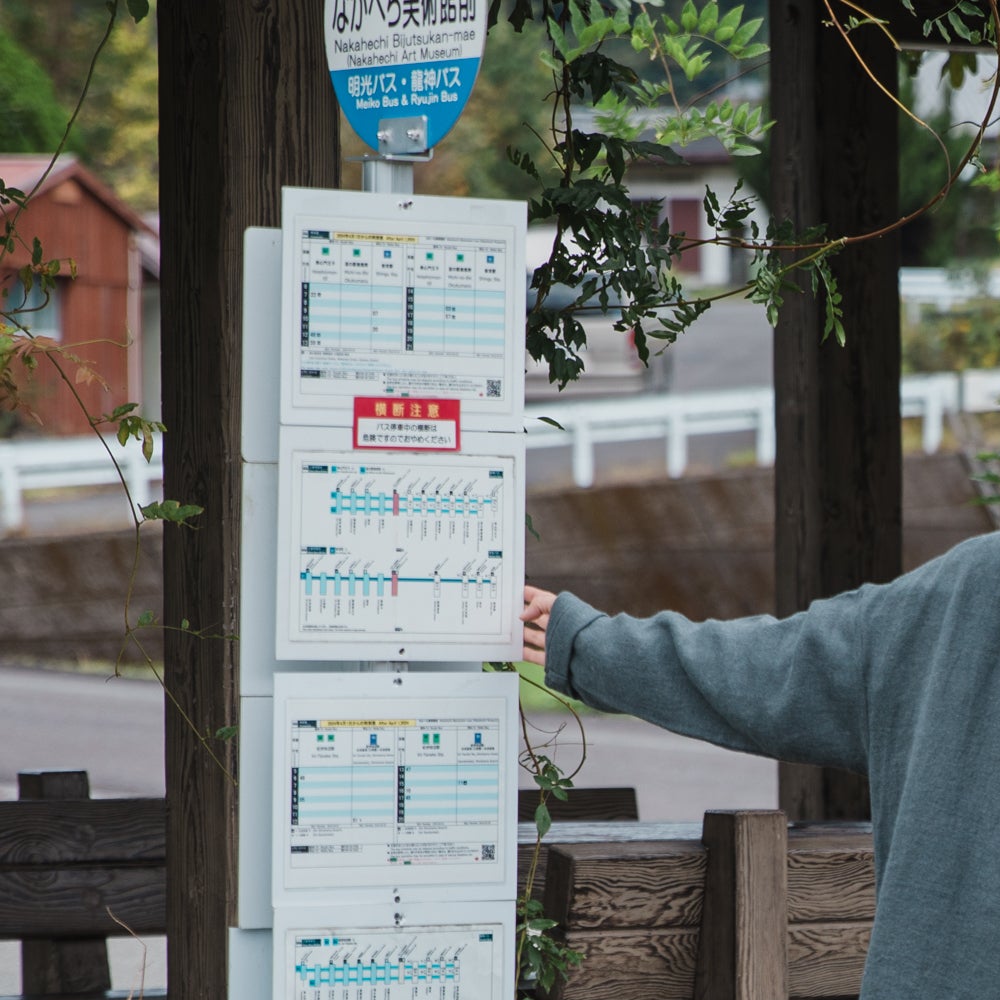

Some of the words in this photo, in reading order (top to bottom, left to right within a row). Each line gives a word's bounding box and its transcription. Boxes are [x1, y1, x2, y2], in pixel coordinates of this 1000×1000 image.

[334, 35, 389, 53] Nakahechi
[392, 30, 476, 49] Bijutsukan-mae
[346, 51, 398, 67] (Nakahechi
[402, 49, 417, 61] Art
[420, 44, 463, 60] Museum)
[356, 98, 380, 110] Meiko
[382, 95, 399, 108] Bus
[401, 94, 408, 106] &
[410, 92, 439, 106] Ryujin
[440, 90, 458, 103] Bus
[375, 402, 439, 418] 横断注意
